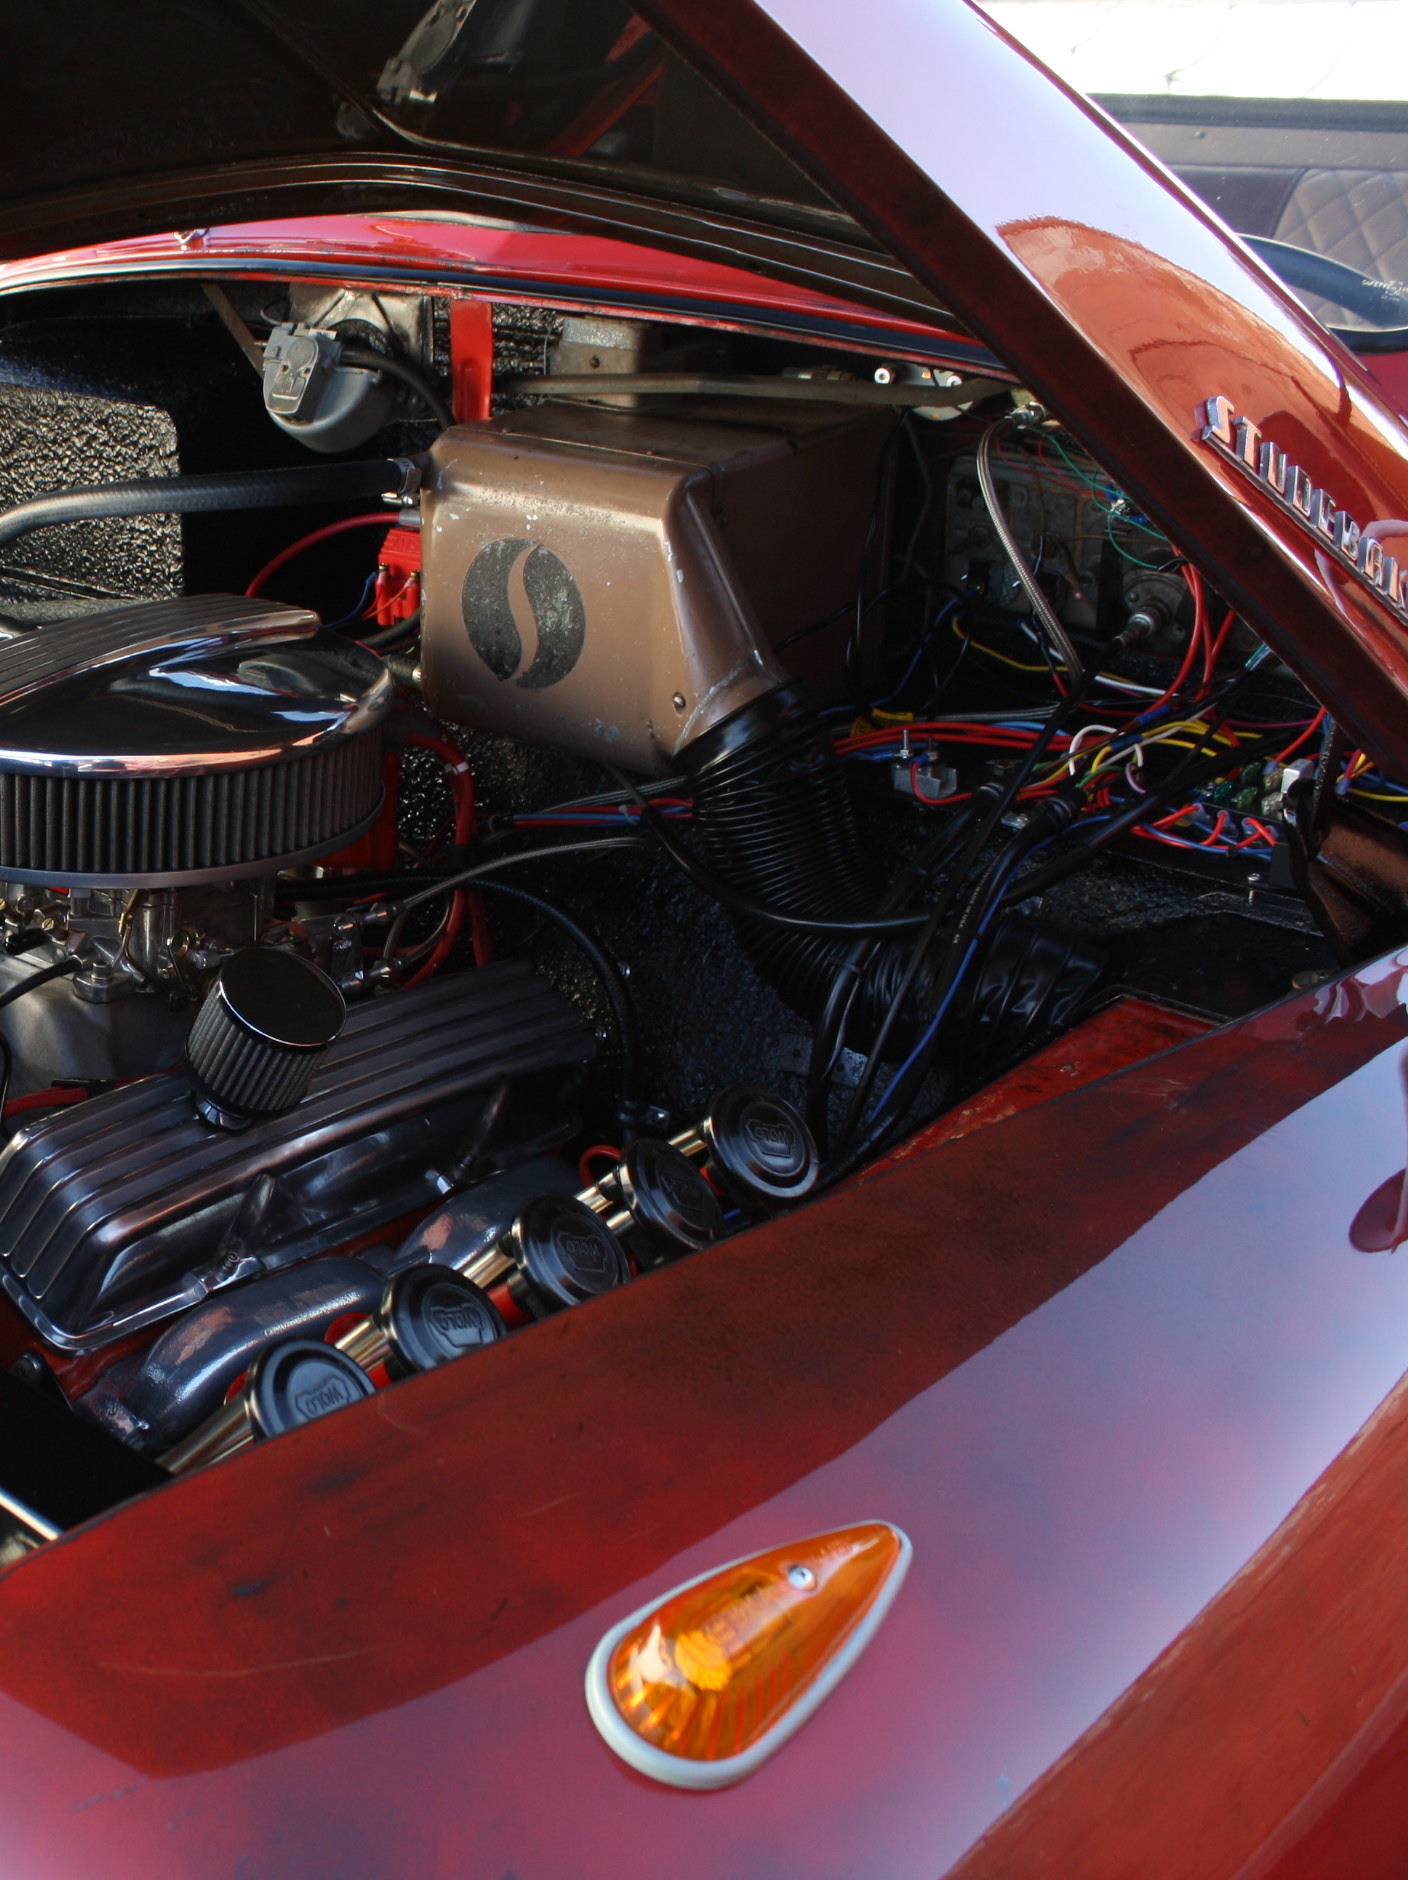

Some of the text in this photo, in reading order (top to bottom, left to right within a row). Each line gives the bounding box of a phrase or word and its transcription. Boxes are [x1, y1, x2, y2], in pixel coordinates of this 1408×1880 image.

[1203, 395, 1408, 616] STUDEBAK
[754, 1126, 789, 1145] WOLO
[565, 1239, 601, 1259] WOLO
[439, 1311, 476, 1331] WOLO
[305, 1384, 343, 1415] WOLO
